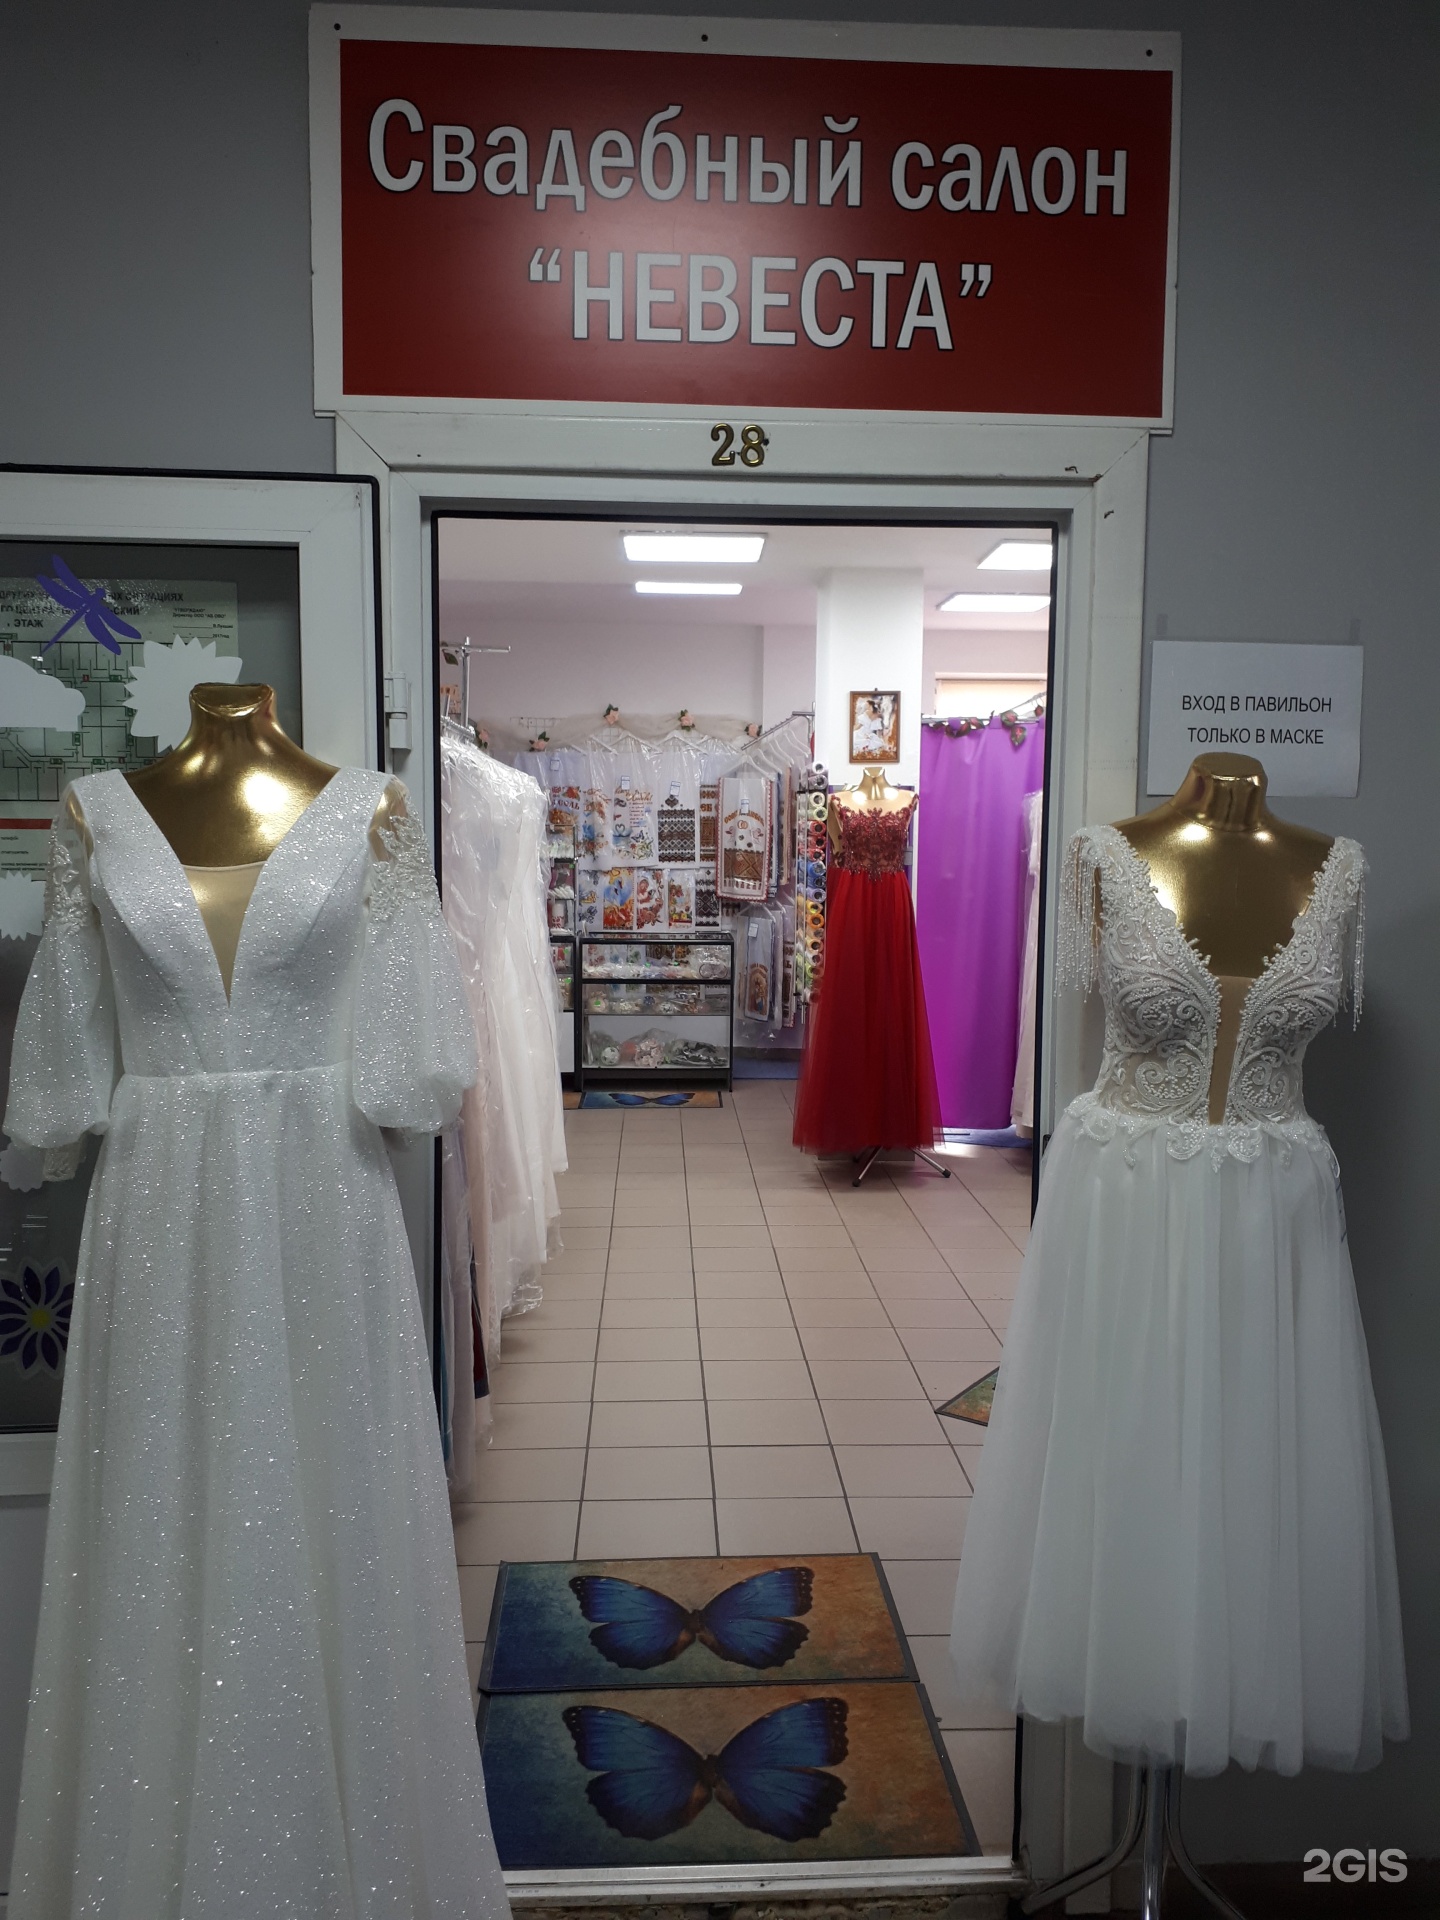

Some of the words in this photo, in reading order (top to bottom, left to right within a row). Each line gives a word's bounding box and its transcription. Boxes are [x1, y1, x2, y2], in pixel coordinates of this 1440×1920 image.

[367, 97, 864, 212] Свадебный
[890, 140, 1128, 216] салон
[711, 422, 765, 468] 28
[14, 618, 44, 628] ЭТАЖ
[1182, 695, 1226, 714] ВХОД
[1230, 695, 1240, 711] В
[1245, 696, 1332, 713] ПАВИЛЬОН
[1187, 727, 1251, 743] ТОЛЬКО
[1256, 728, 1266, 743] В
[1270, 728, 1324, 744] МАСКЕ
